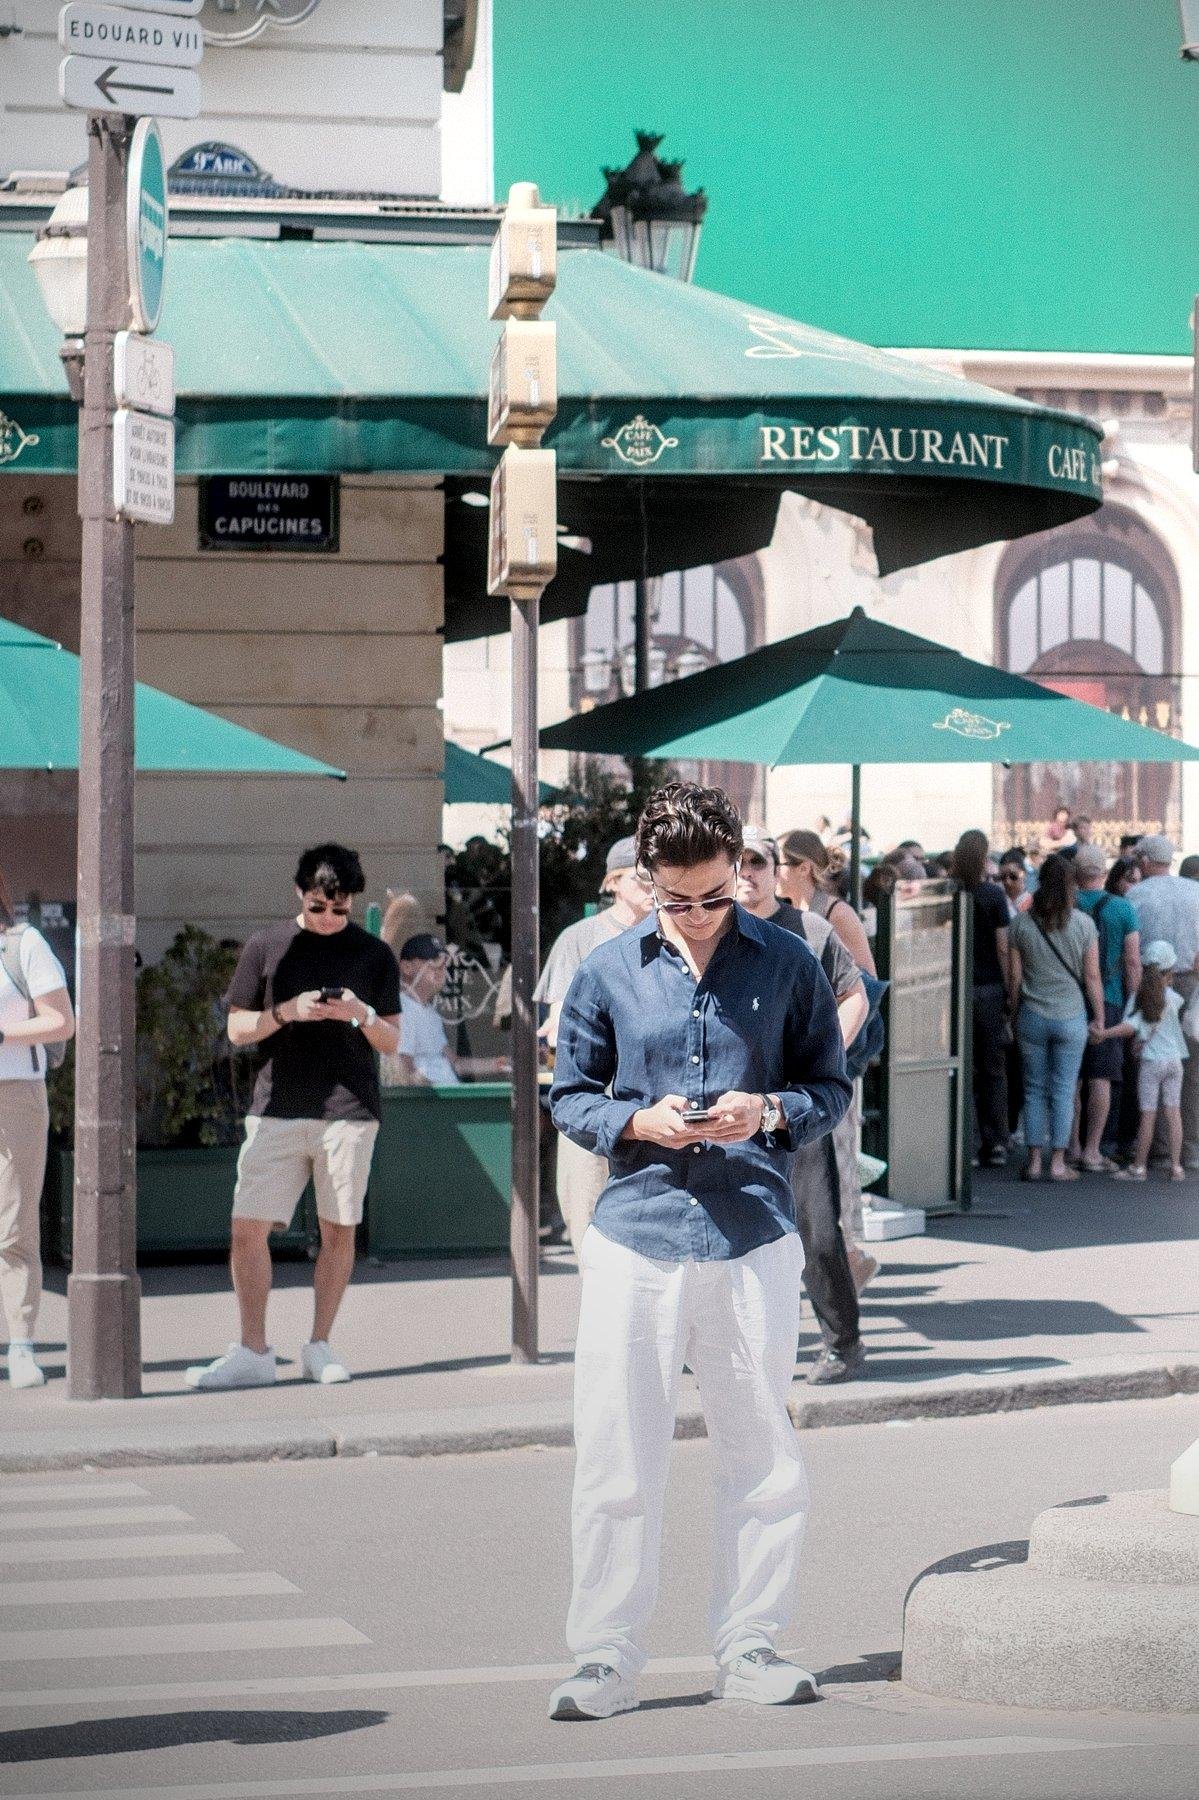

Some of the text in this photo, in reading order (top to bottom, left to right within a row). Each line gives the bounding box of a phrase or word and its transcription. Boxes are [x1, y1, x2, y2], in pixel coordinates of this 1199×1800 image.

[70, 20, 198, 50] EDOUARD VII
[758, 425, 1009, 470] RESTAURANT
[228, 480, 309, 499] BOULEVARD
[214, 516, 322, 535] CAPUCINES
